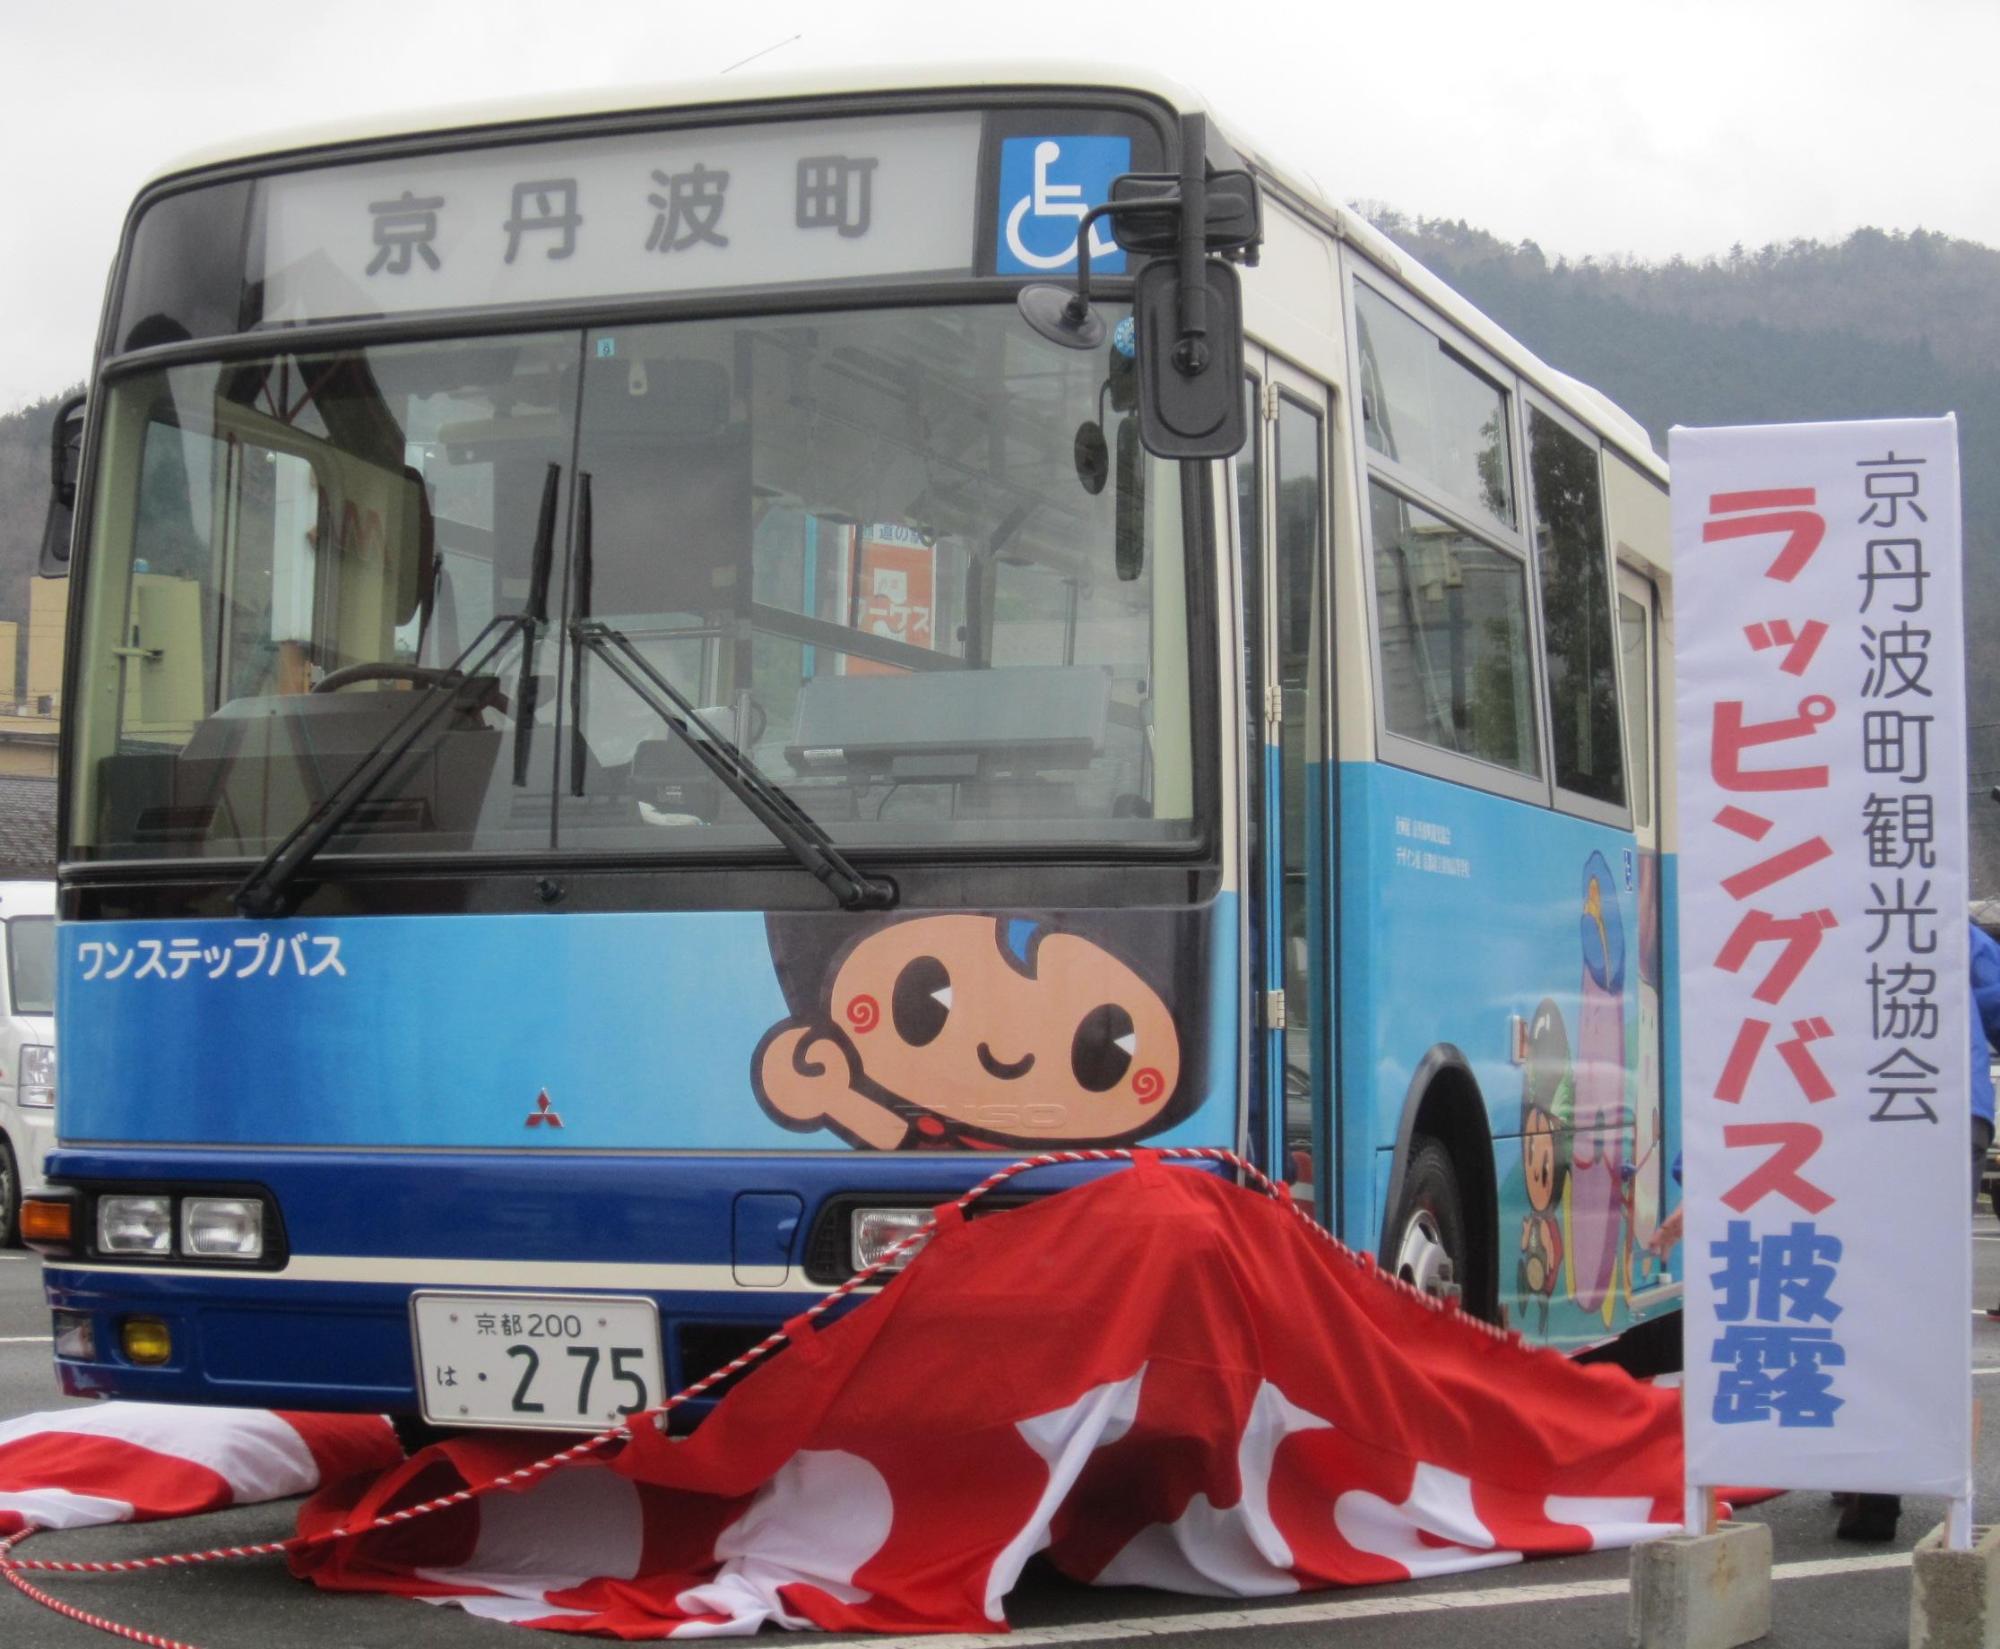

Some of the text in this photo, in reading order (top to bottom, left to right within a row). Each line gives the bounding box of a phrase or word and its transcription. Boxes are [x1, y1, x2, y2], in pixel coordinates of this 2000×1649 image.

[364, 155, 879, 276] 京丹波町
[1856, 450, 1940, 1125] 京丹波町観光協会
[78, 932, 347, 981] ワンステップバス
[1702, 486, 1846, 1429] ラッピングバス披露
[436, 1366, 458, 1387] は
